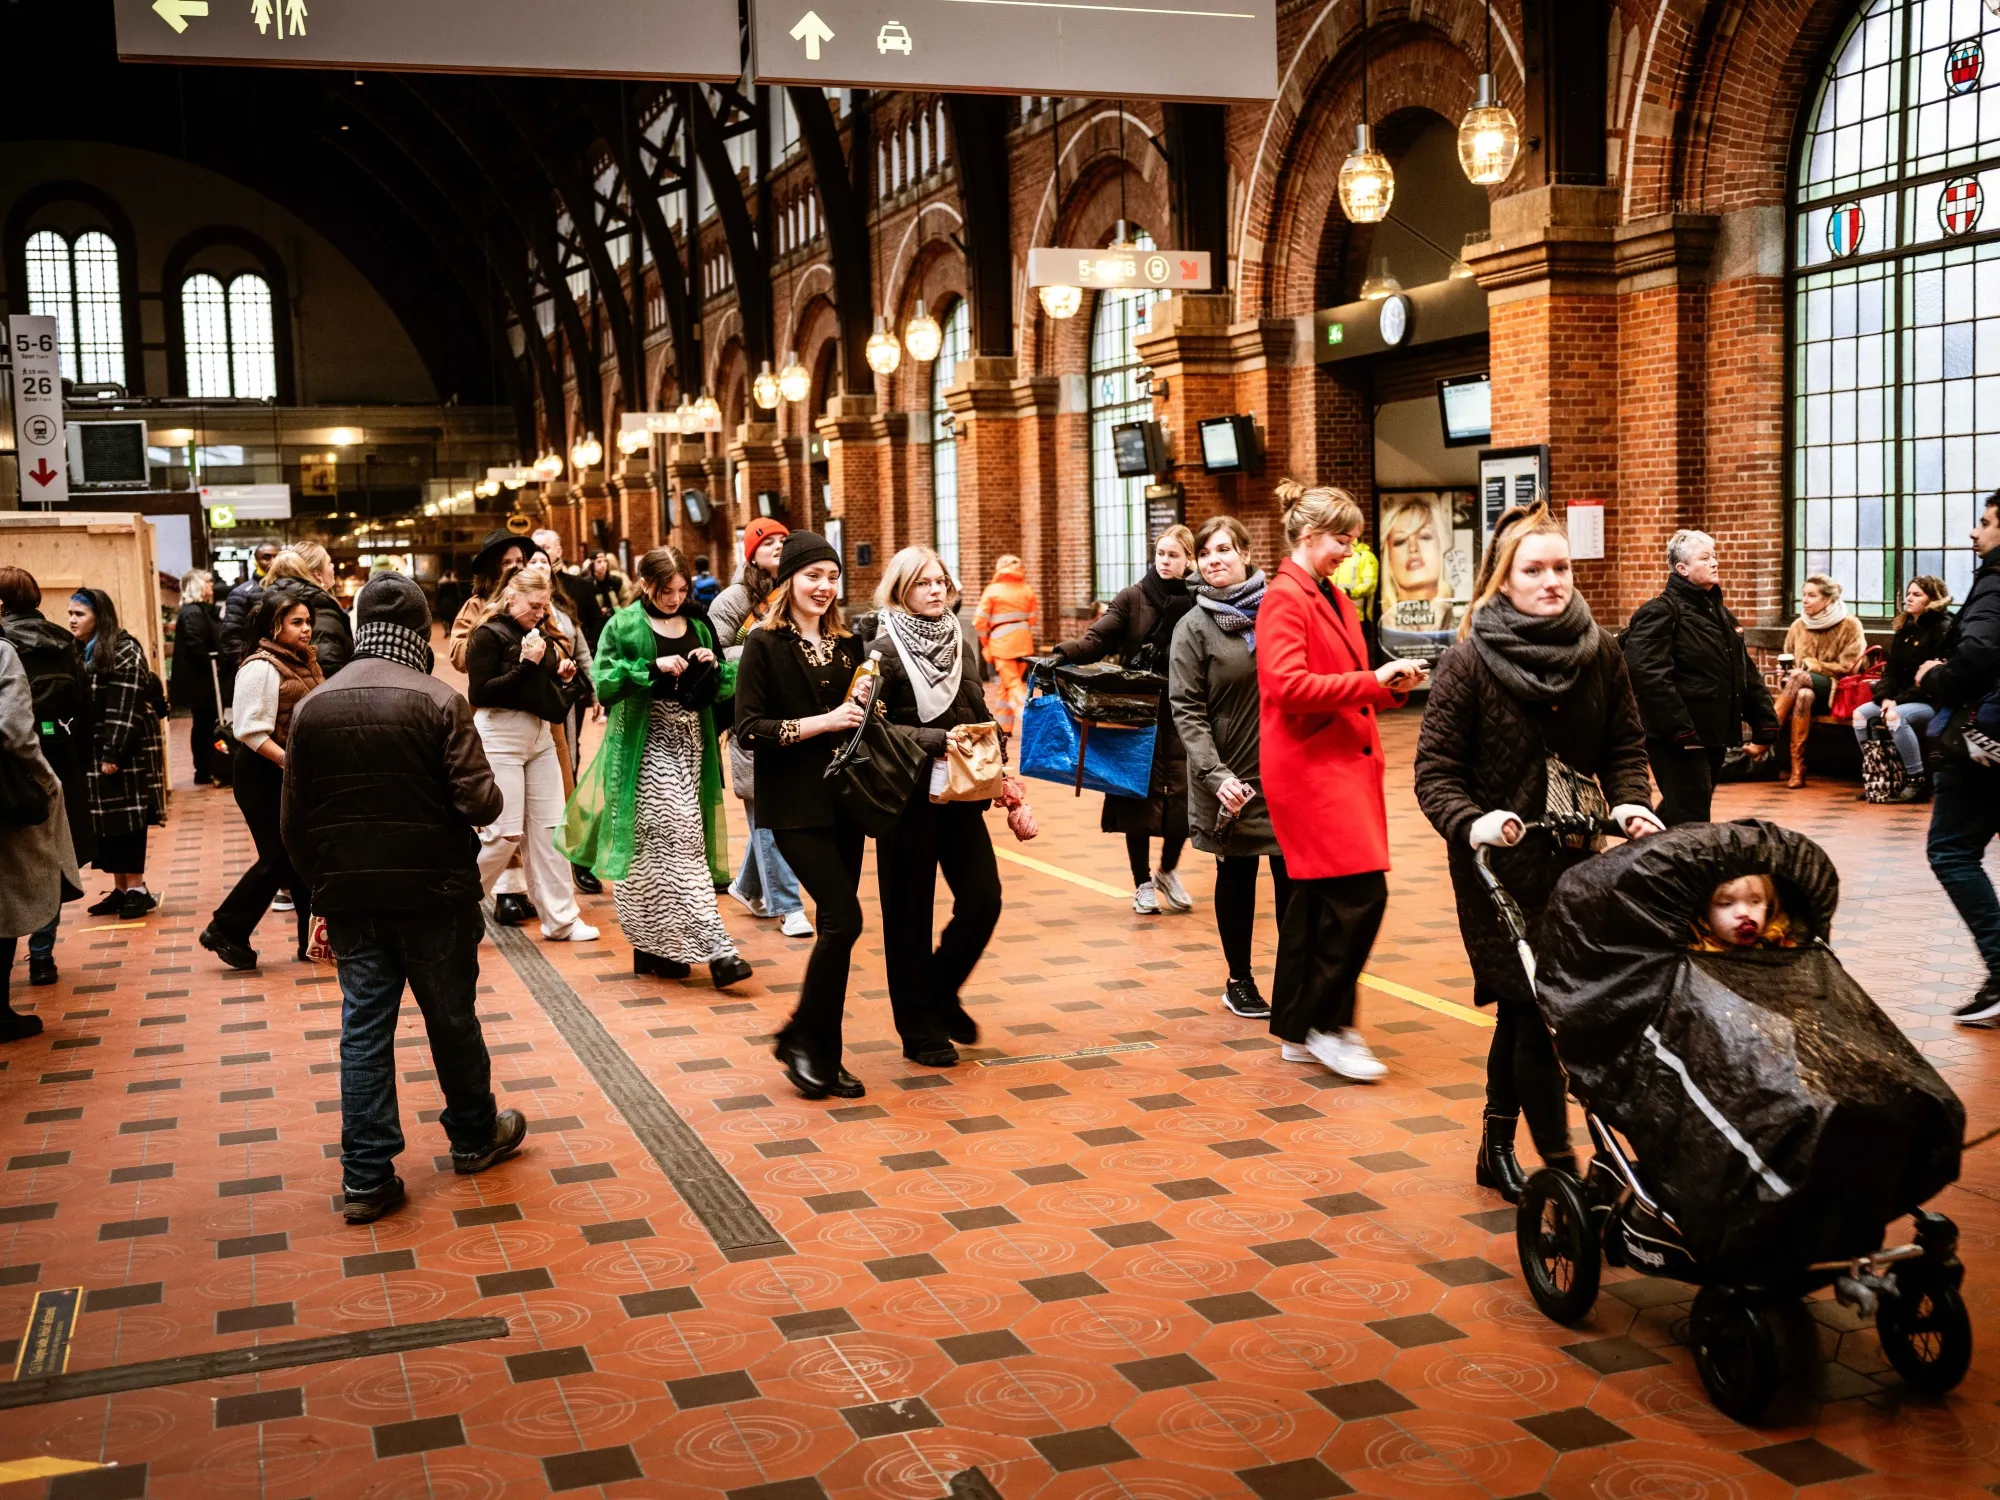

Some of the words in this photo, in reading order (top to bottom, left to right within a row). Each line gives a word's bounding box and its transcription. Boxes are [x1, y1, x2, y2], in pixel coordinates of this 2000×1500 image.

[16, 334, 53, 352] 5-6
[22, 377, 52, 395] 26
[1396, 613, 1434, 624] TOMMY
